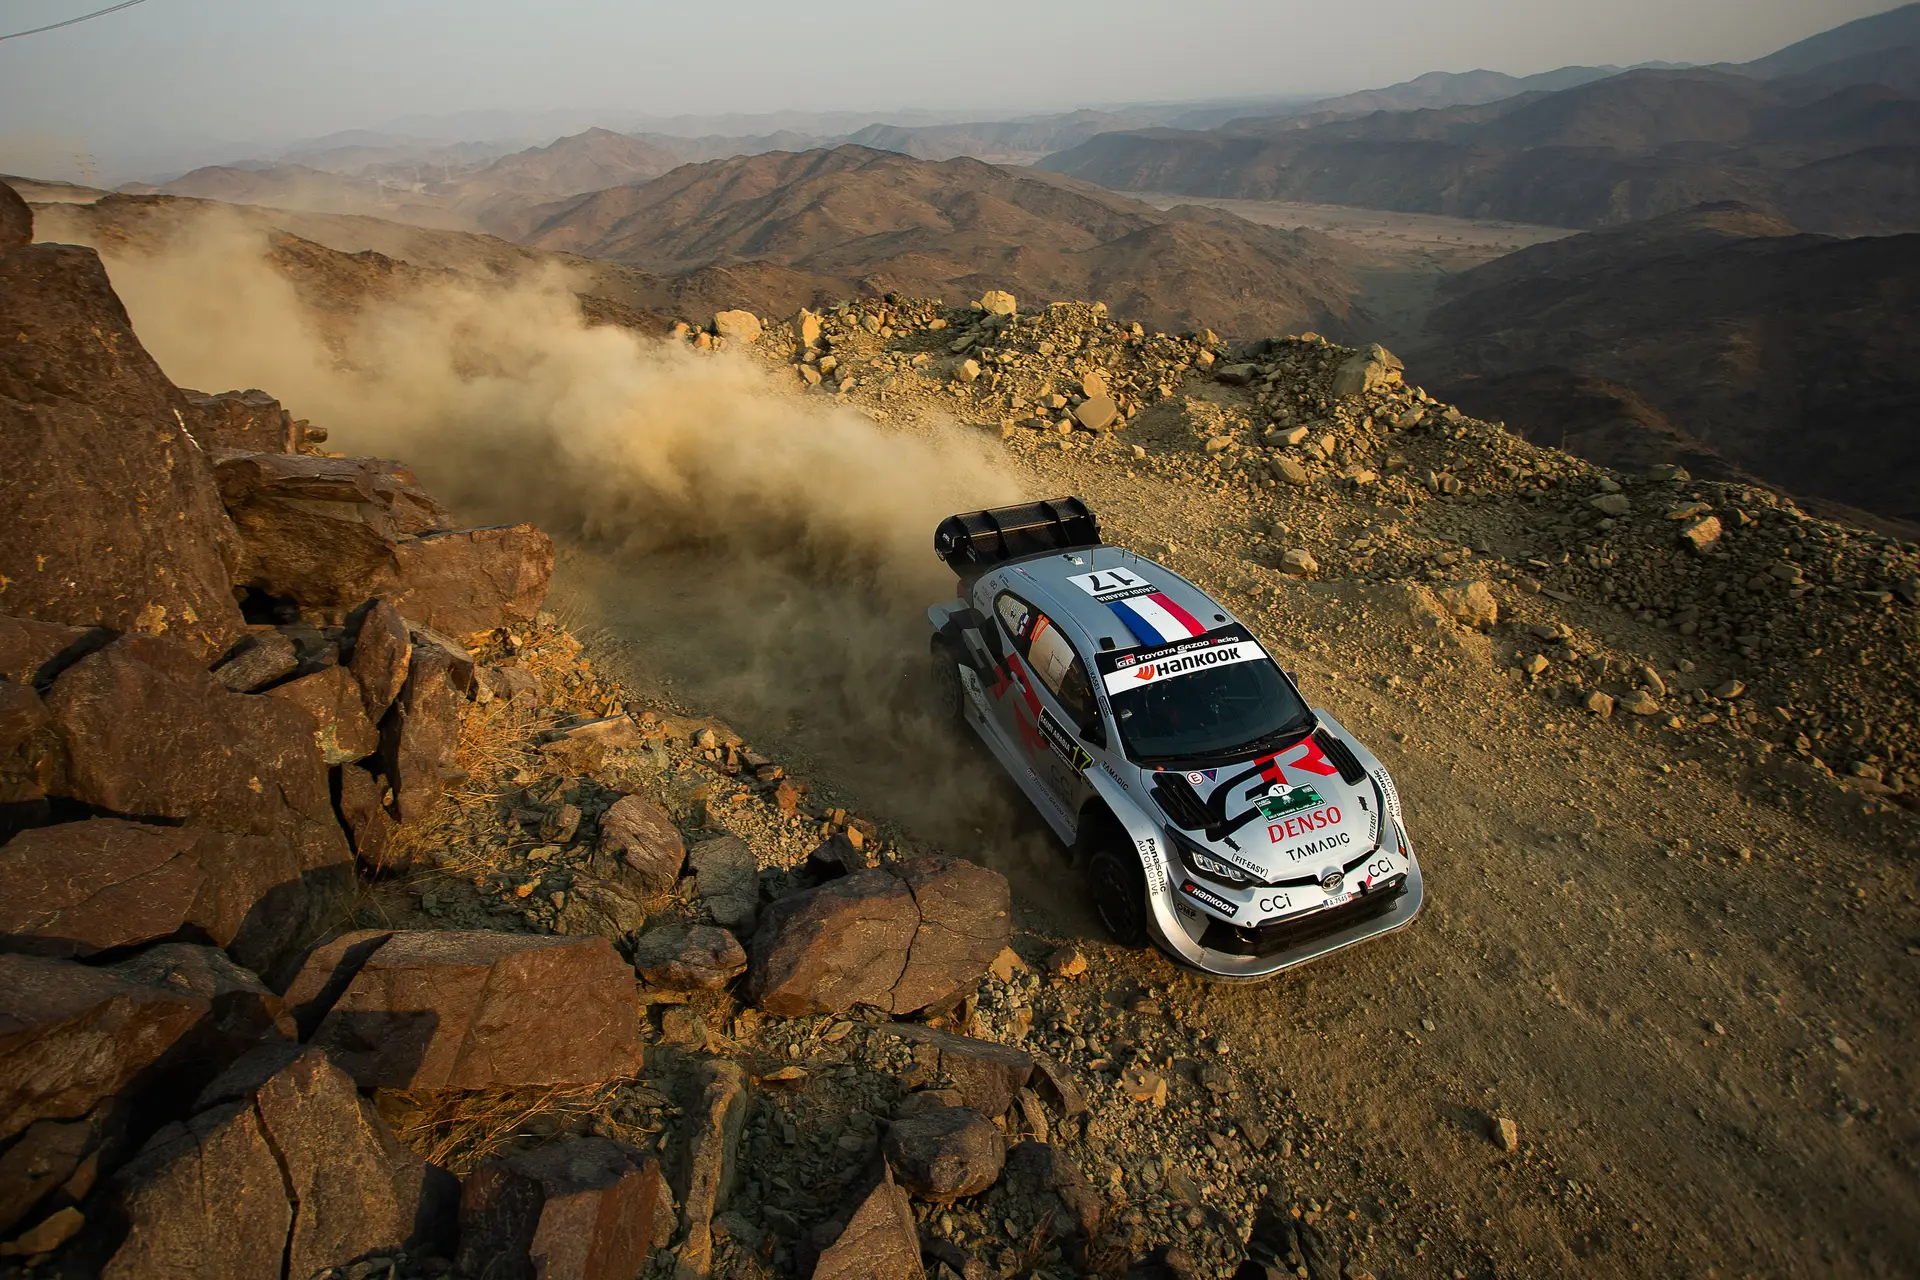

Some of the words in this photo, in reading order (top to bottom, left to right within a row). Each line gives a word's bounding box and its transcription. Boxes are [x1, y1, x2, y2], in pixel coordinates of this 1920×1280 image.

[1088, 571, 1135, 592] 17
[1129, 586, 1157, 596] SAUDI
[1096, 591, 1130, 602] ARABIA
[1029, 614, 1050, 643] 17
[1137, 647, 1176, 661] TOYOTA
[1210, 636, 1240, 646] Racing
[1072, 745, 1092, 772] 17
[1102, 760, 1129, 791] TAMADIC
[1273, 785, 1286, 795] 17
[1378, 767, 1401, 817] AUTOMOTIVE
[1267, 806, 1342, 844] DENSO
[1286, 832, 1350, 861] TAMADIC
[1136, 839, 1160, 897] AUTOMOTIVE
[1145, 837, 1168, 893] Panasonic
[1368, 857, 1394, 877] CCi
[1176, 902, 1197, 919] OMP
[1259, 893, 1292, 913] CCi
